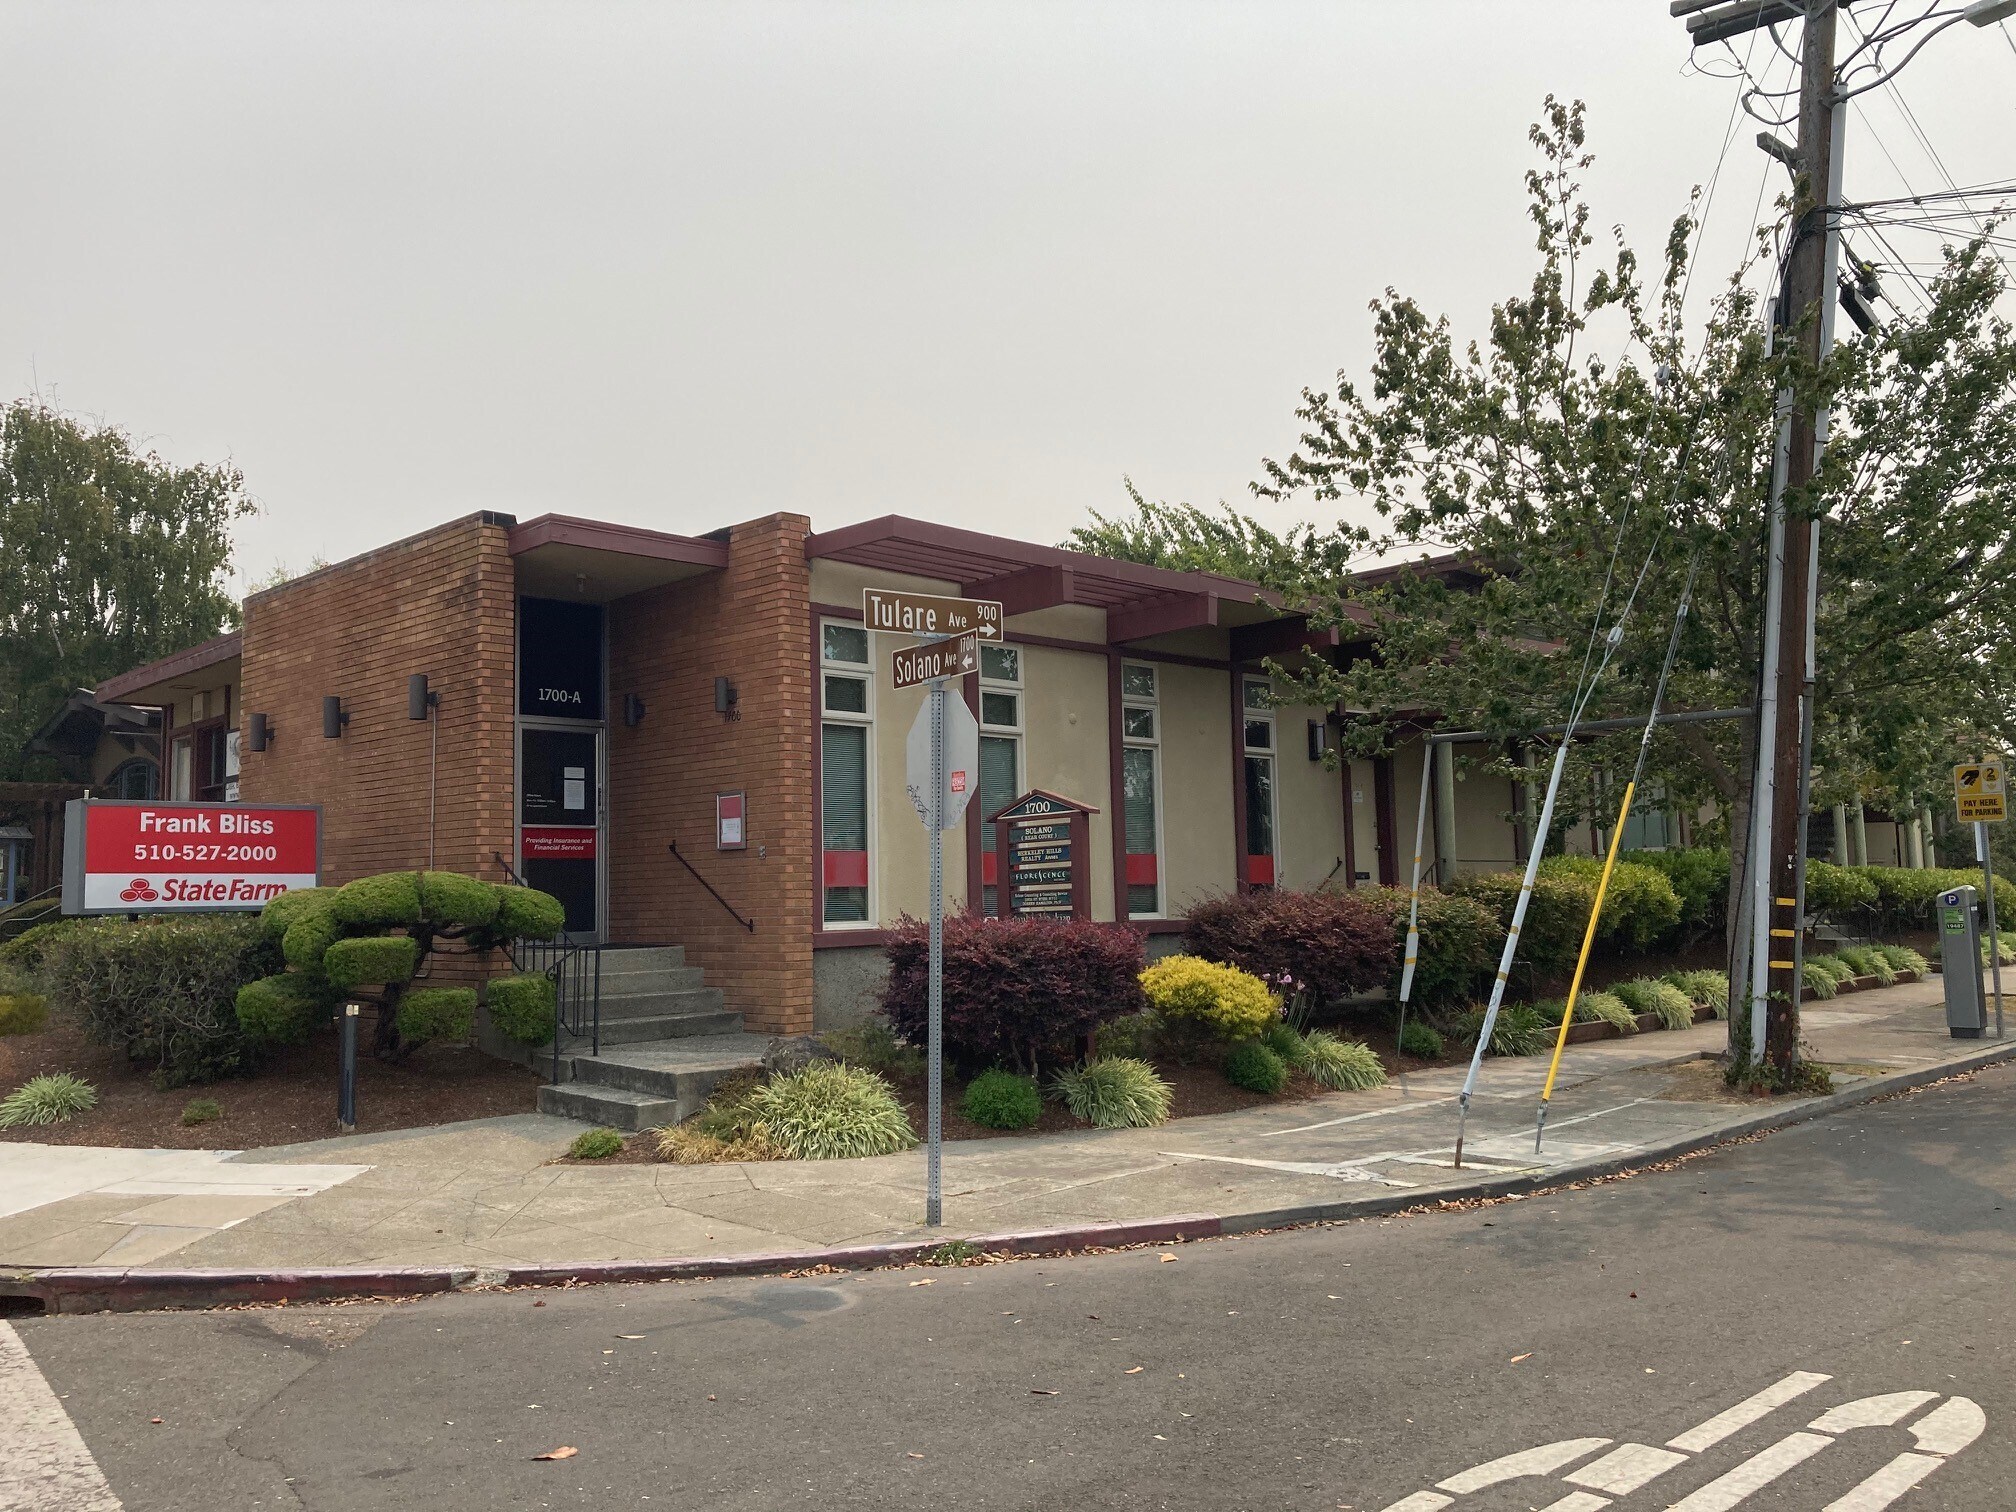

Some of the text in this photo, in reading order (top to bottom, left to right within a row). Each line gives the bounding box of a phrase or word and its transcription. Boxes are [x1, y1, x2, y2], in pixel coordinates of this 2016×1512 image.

[871, 596, 997, 631] Tulare Ave 900
[896, 635, 974, 684] Solano Ave 1700
[538, 688, 581, 704] 1700-A
[1024, 801, 1051, 814] 1700
[1975, 807, 2003, 816] PARKING
[140, 812, 274, 835] Frank Bliss
[1025, 826, 1053, 835] SOLANO
[134, 844, 277, 861] 510-527-2000
[1948, 895, 1956, 904] P
